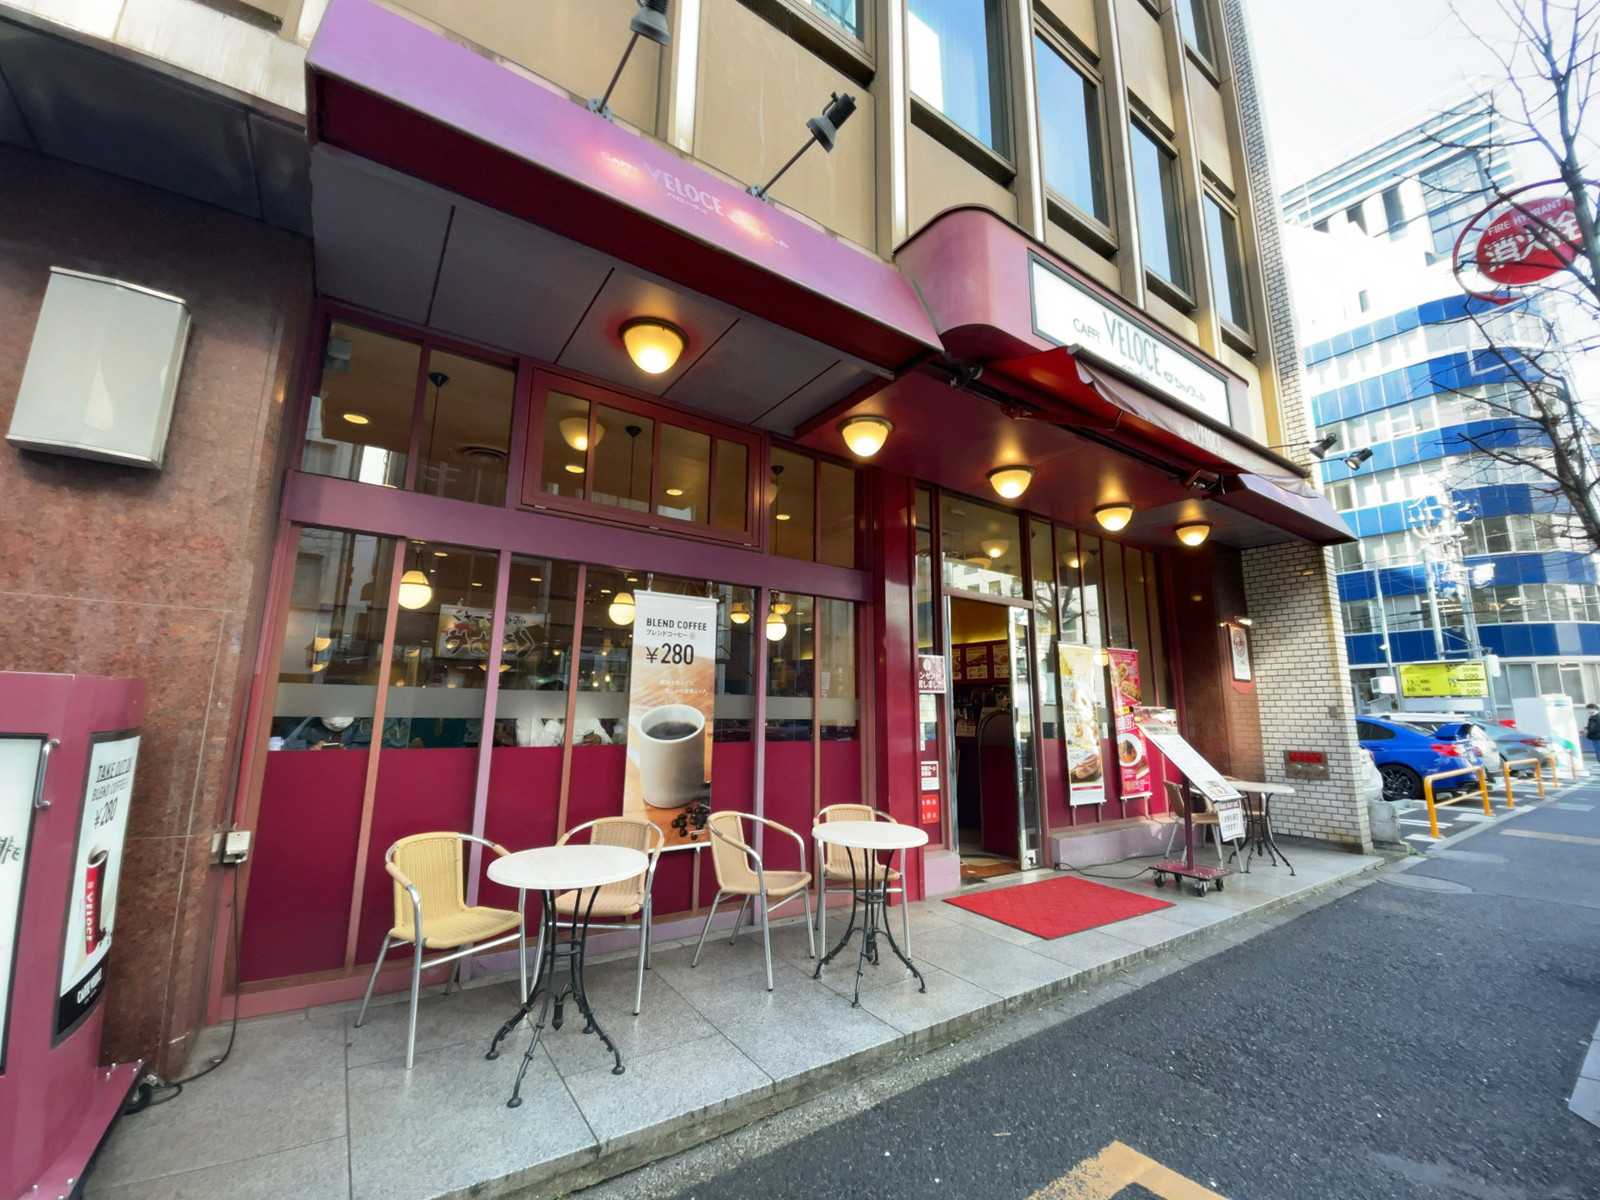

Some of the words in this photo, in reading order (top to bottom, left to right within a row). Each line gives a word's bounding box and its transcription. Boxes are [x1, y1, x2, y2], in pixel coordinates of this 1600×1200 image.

[643, 160, 725, 217] VELOCE
[1487, 221, 1511, 236] FIRE
[1513, 199, 1562, 226] HYRANT
[1484, 210, 1583, 273] 消火栓
[1072, 317, 1102, 345] CAFFE
[1102, 311, 1162, 377] VELOCE
[646, 617, 675, 629] BLEND
[677, 620, 708, 632] COFFEE
[646, 629, 688, 639] ブレンドコーヒー
[645, 642, 695, 666] ¥280
[96, 762, 116, 782] TAKE
[91, 785, 111, 802] BLEND
[93, 797, 119, 829] ¥280
[86, 891, 94, 942] VELOCE
